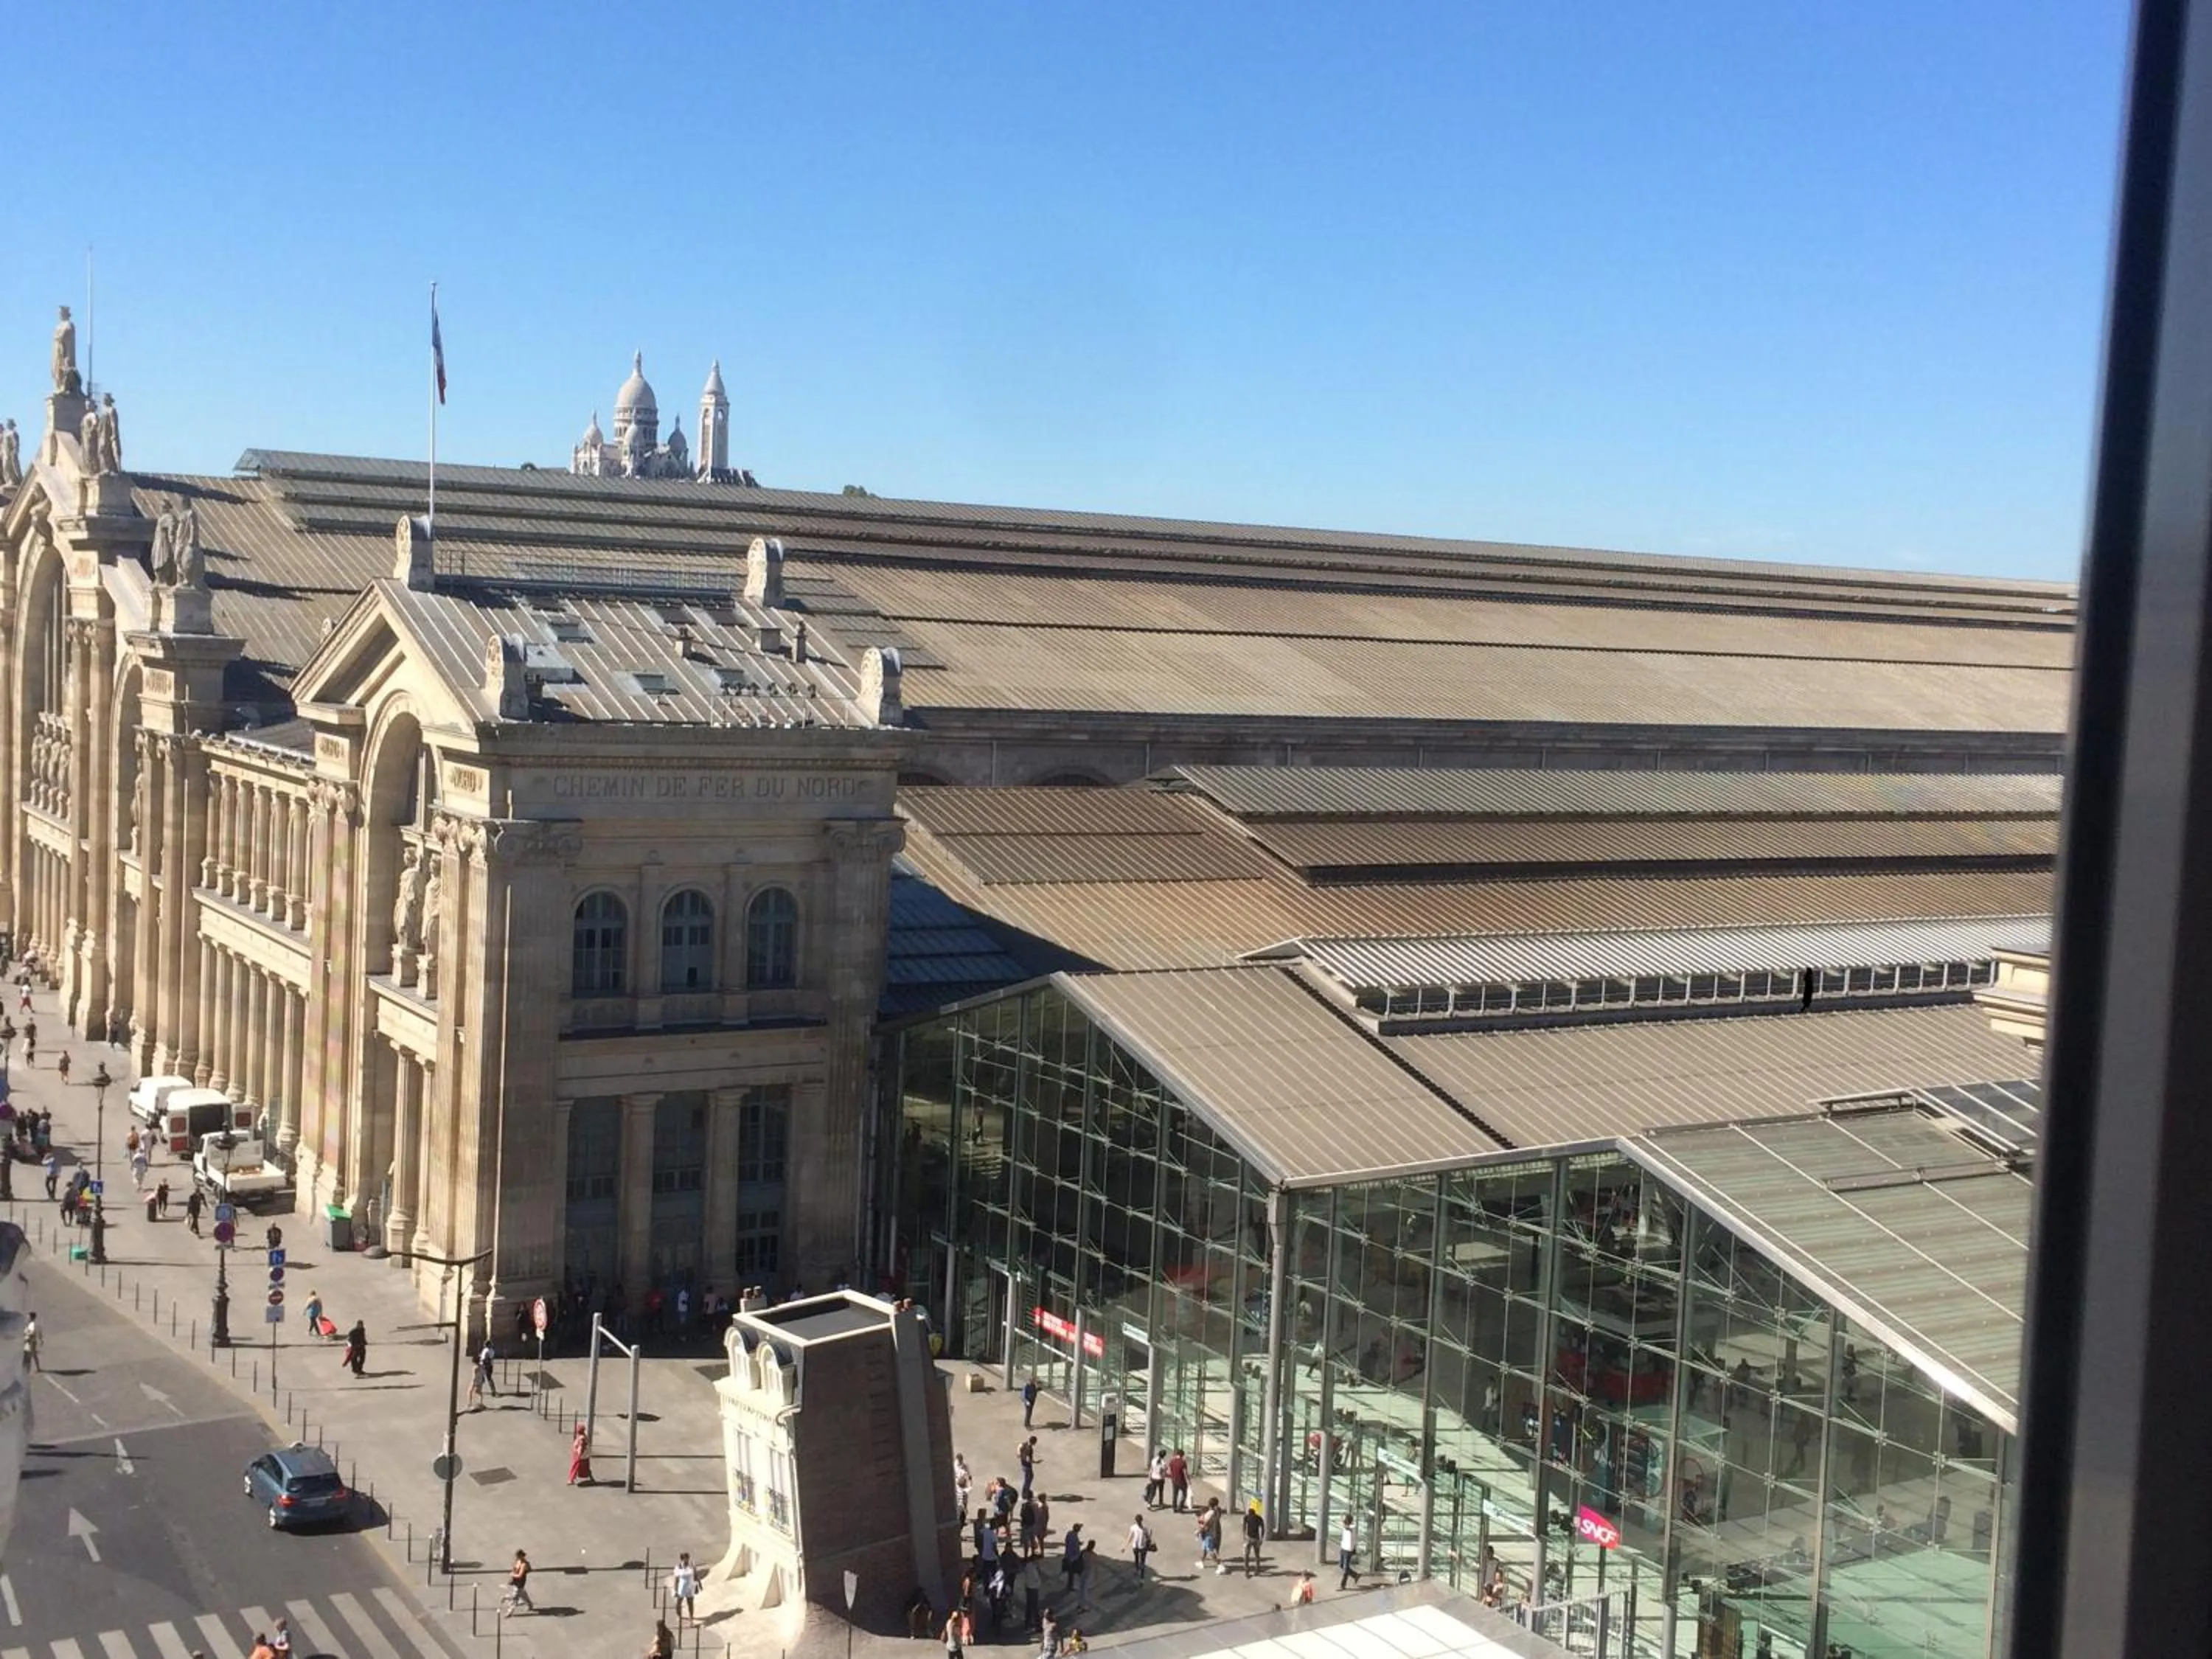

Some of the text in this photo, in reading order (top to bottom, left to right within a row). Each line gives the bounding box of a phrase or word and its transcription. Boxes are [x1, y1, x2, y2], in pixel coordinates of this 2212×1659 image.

[554, 775, 855, 799] CHEMIN DE FER DU NORD
[1579, 1518, 1618, 1544] SNCF
